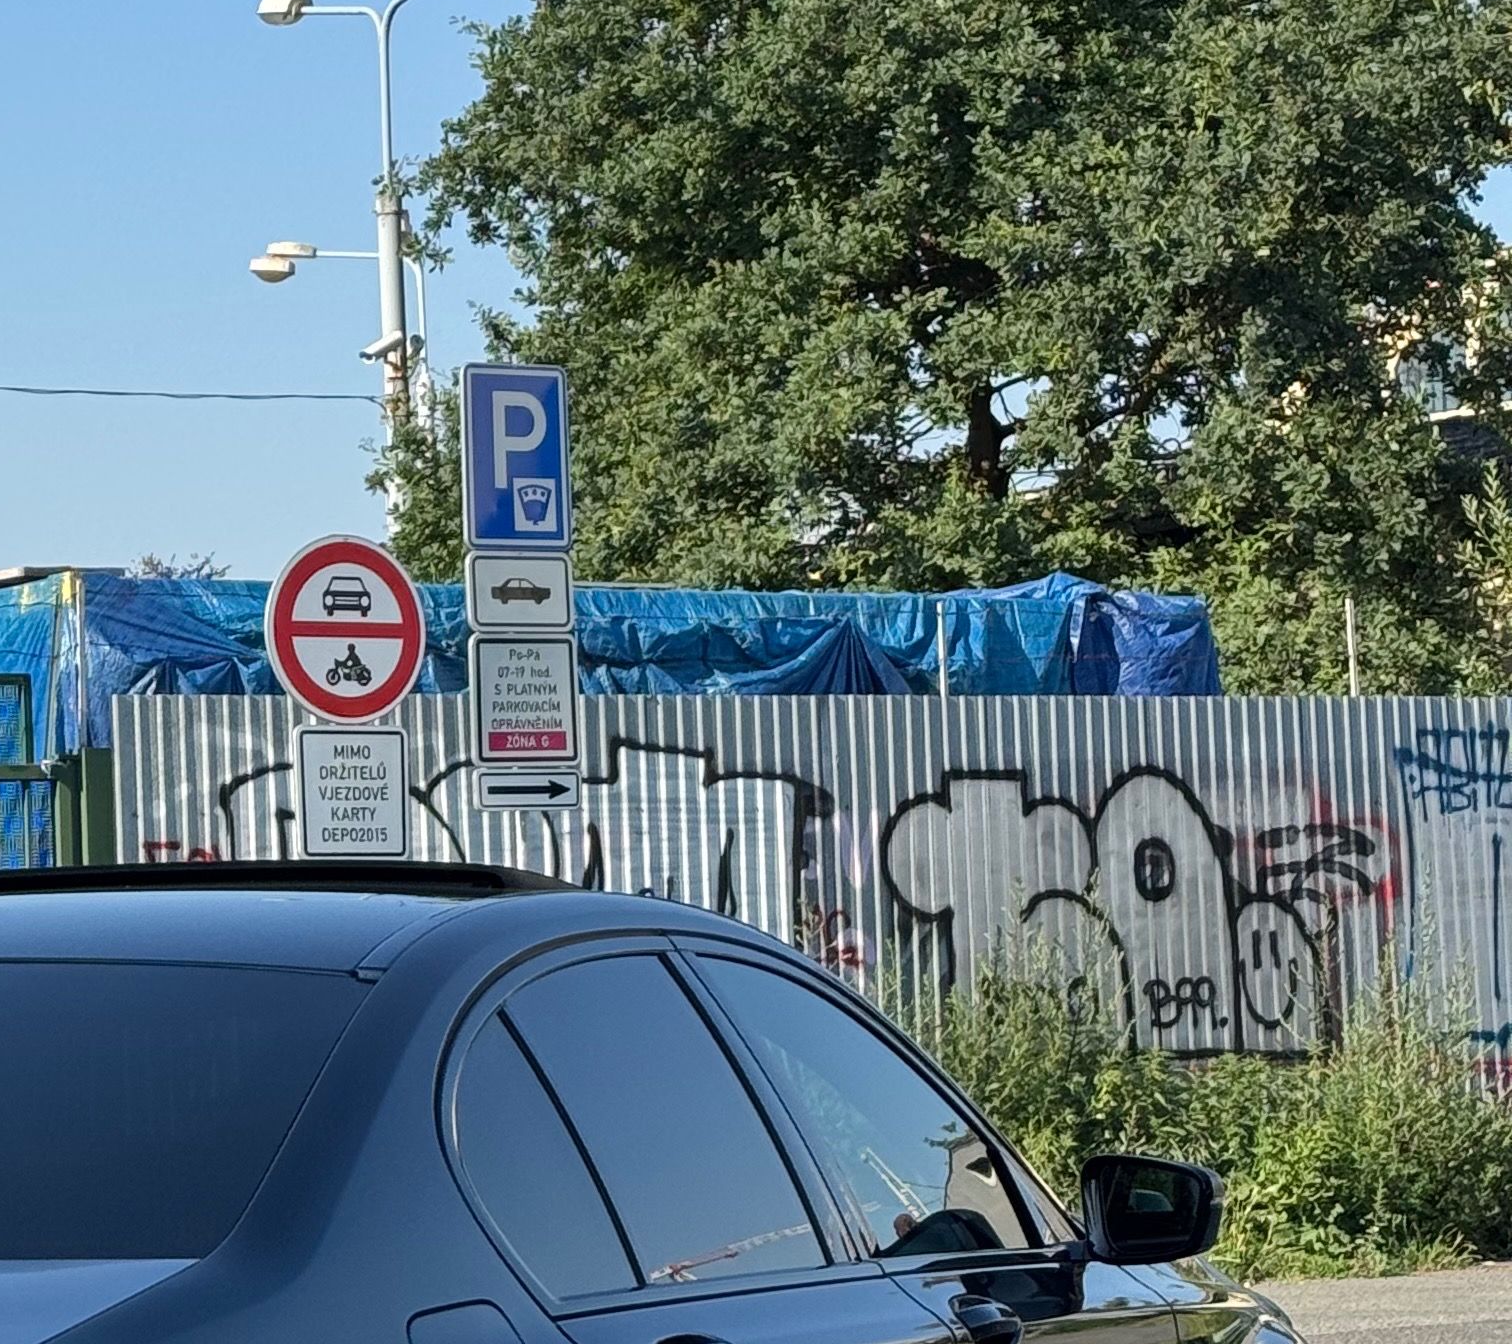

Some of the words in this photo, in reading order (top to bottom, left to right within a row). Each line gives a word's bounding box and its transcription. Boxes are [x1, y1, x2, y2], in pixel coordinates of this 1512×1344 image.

[492, 390, 547, 489] P
[494, 683, 502, 696] S
[506, 680, 558, 696] PLATNÝM
[492, 698, 561, 713] PARKOVACÍM
[491, 715, 563, 730] OPRÁVNĚNÍM
[505, 732, 537, 748] ZÓNA
[333, 744, 371, 760] MIMO
[319, 760, 387, 781] DRŽITELŮ
[318, 782, 390, 801] VJEZDOVÉ
[330, 806, 377, 822] KARTY
[321, 827, 388, 843] DEPO2015
